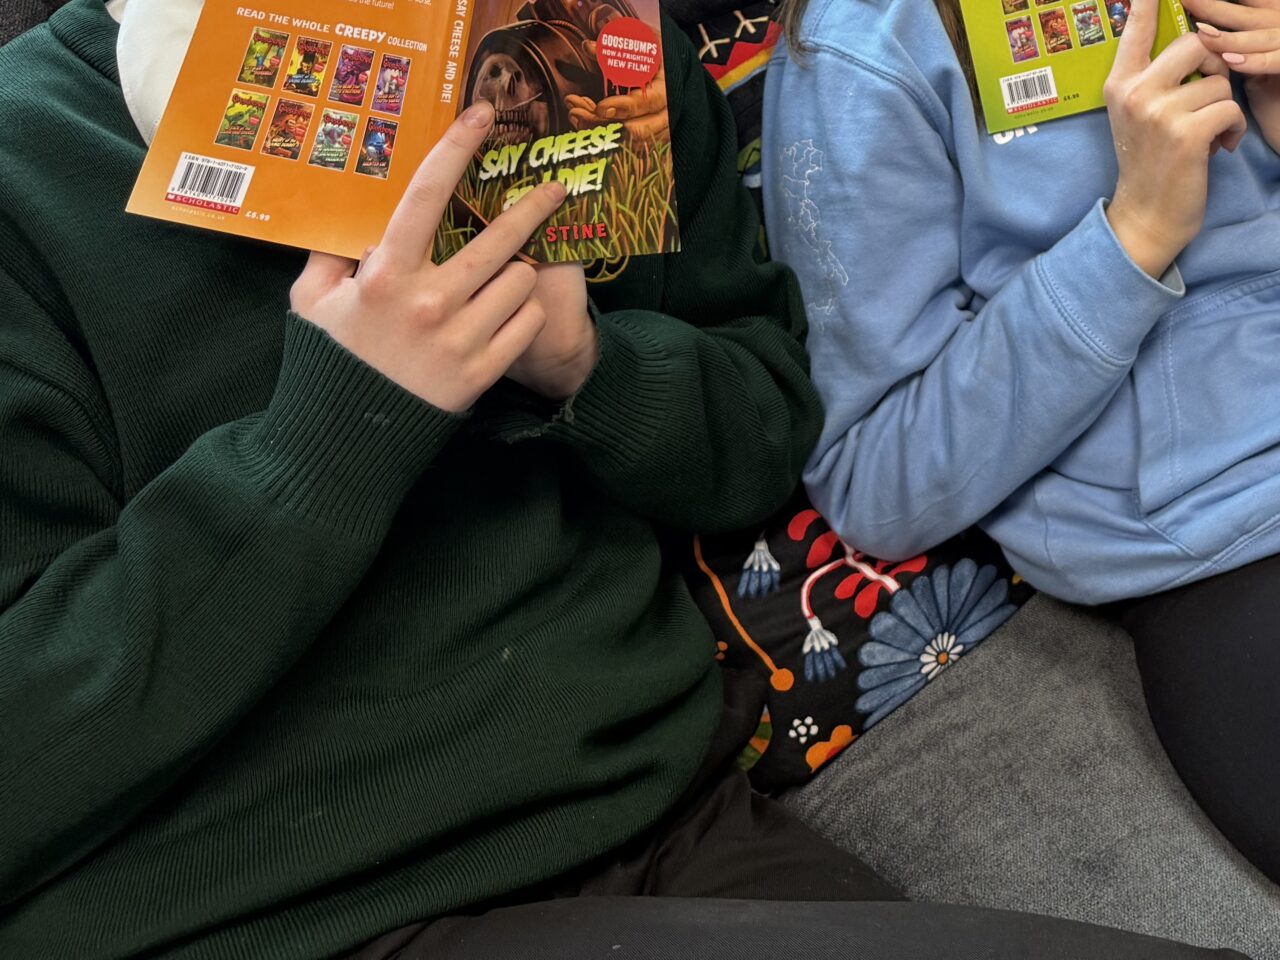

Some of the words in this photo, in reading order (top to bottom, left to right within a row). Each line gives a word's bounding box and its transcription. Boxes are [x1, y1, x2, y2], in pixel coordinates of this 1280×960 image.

[236, 6, 266, 20] READ
[268, 12, 291, 25] THE
[292, 18, 331, 33] WHOLE
[334, 22, 387, 44] CREEPY
[387, 36, 428, 52] COLLECTION
[448, 20, 465, 59] CHEESE
[602, 33, 658, 56] GOOSEBUMPS
[602, 48, 616, 58] NOW
[616, 50, 623, 59] A
[622, 51, 656, 64] FRIGHTFUL
[444, 60, 458, 81] AND
[607, 58, 626, 70] NEW
[626, 60, 651, 73] FILM!
[440, 82, 454, 105] DIE!
[478, 142, 529, 182] SAY
[528, 122, 625, 169] CHEESE
[558, 158, 607, 197] DIE!
[176, 196, 239, 214] SCHOLASTIC
[545, 222, 608, 243] STINE
